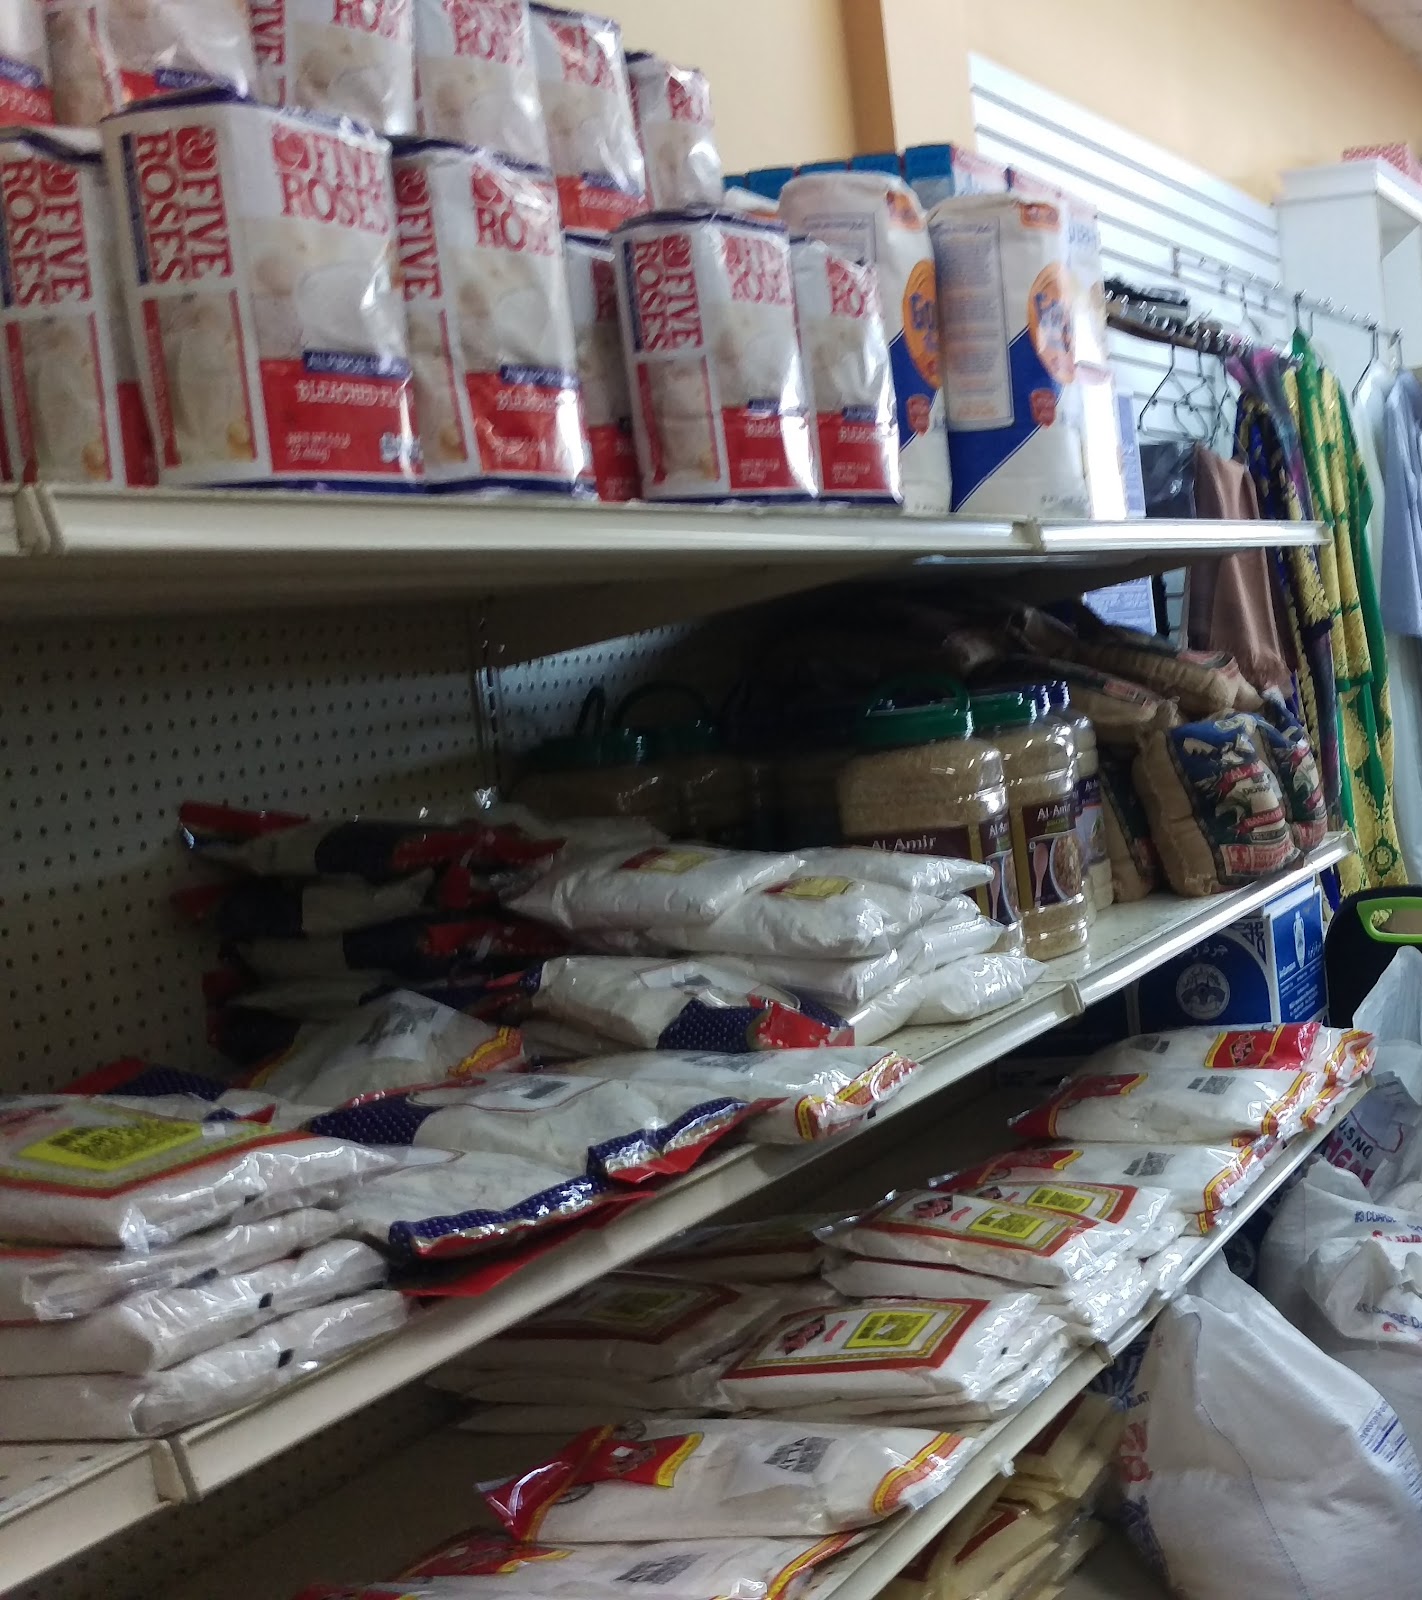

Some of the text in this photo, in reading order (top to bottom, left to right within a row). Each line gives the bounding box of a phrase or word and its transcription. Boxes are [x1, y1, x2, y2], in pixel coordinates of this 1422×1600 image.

[3, 159, 49, 308] ROSES
[43, 200, 92, 303] FIVE
[136, 131, 191, 286] ROSES
[182, 173, 234, 280] FIVE
[398, 207, 442, 302] FIVE
[636, 239, 668, 353] ROSES
[665, 270, 704, 349] FIVE
[871, 834, 938, 853] Al-Amir
